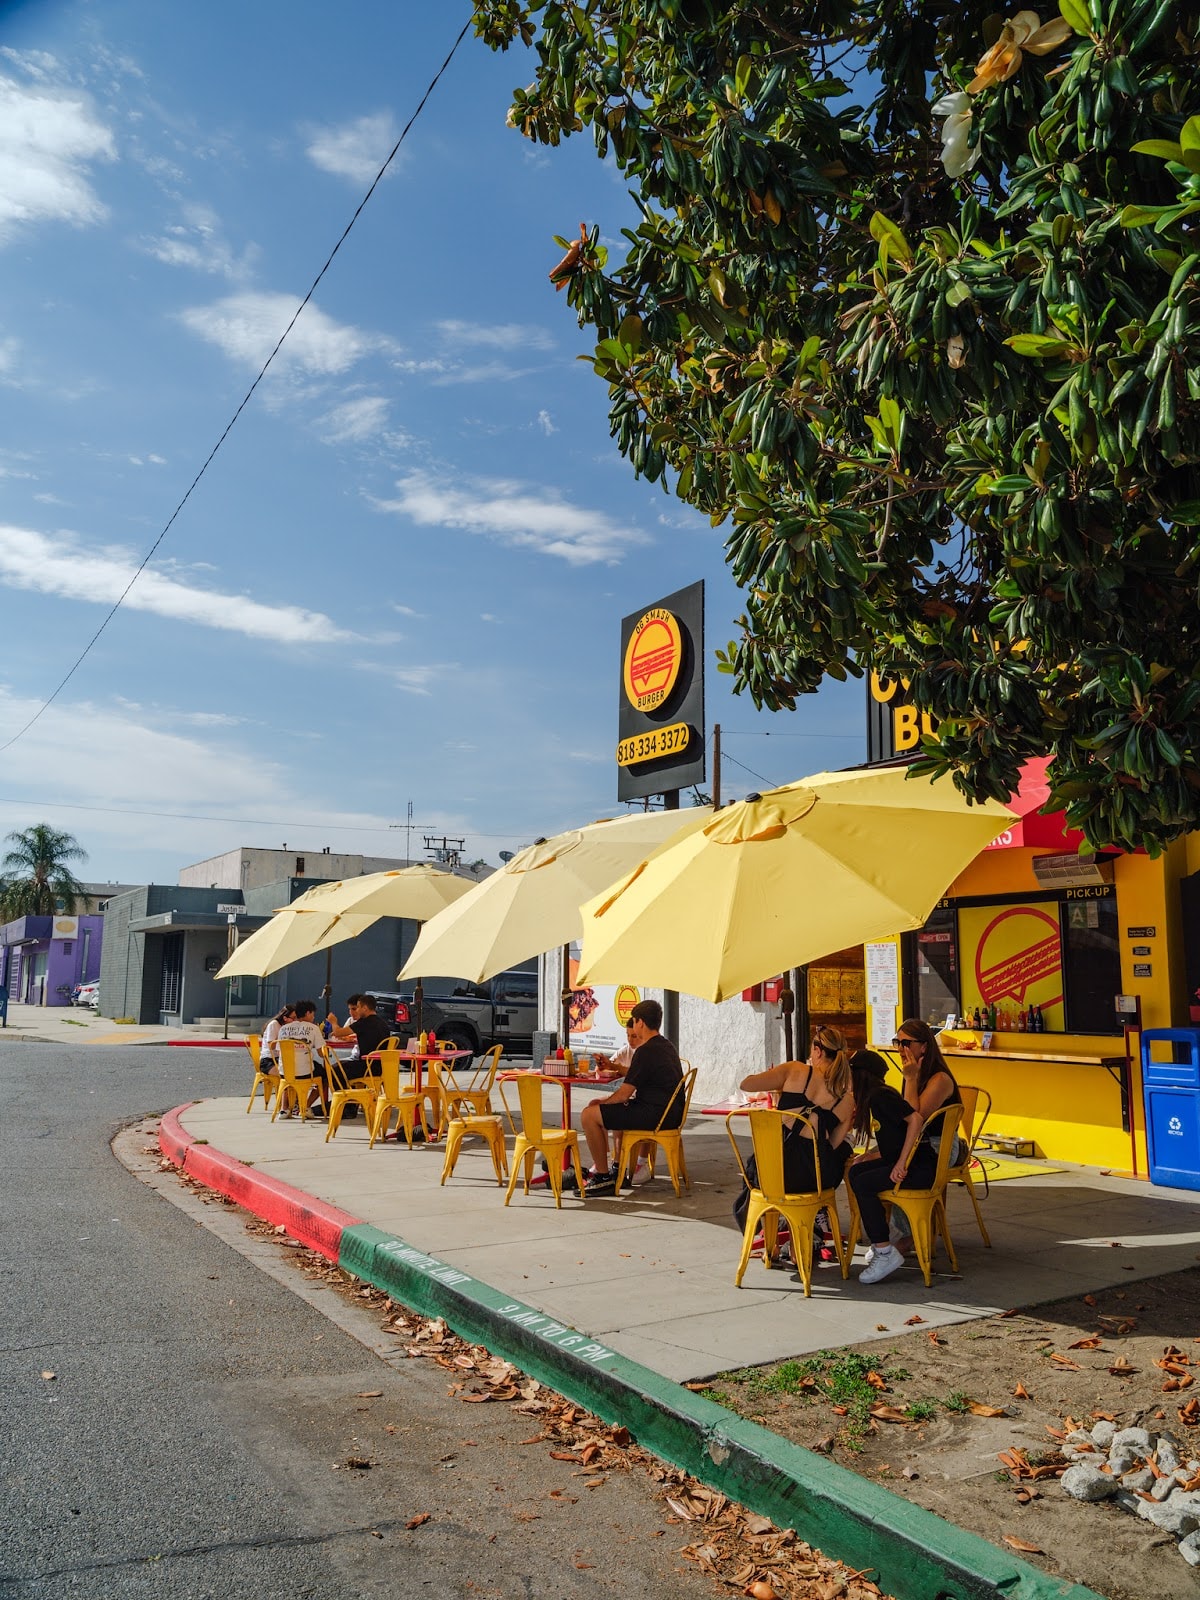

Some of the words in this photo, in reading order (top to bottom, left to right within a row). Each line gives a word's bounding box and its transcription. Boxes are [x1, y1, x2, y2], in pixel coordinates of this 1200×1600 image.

[635, 620, 644, 634] OG
[645, 609, 670, 623] SMASH
[637, 690, 665, 708] BURGER
[617, 726, 687, 763] 818-334-3372
[1066, 887, 1110, 899] PICK-UP
[220, 905, 238, 913] Justin
[1072, 907, 1084, 923] A
[391, 1248, 440, 1269] MINUTE
[429, 1266, 473, 1286] LIMIT
[497, 1304, 520, 1314] 9
[508, 1312, 546, 1326] AM
[535, 1322, 567, 1338] TO
[558, 1335, 583, 1347] 6
[573, 1343, 615, 1362] PM
